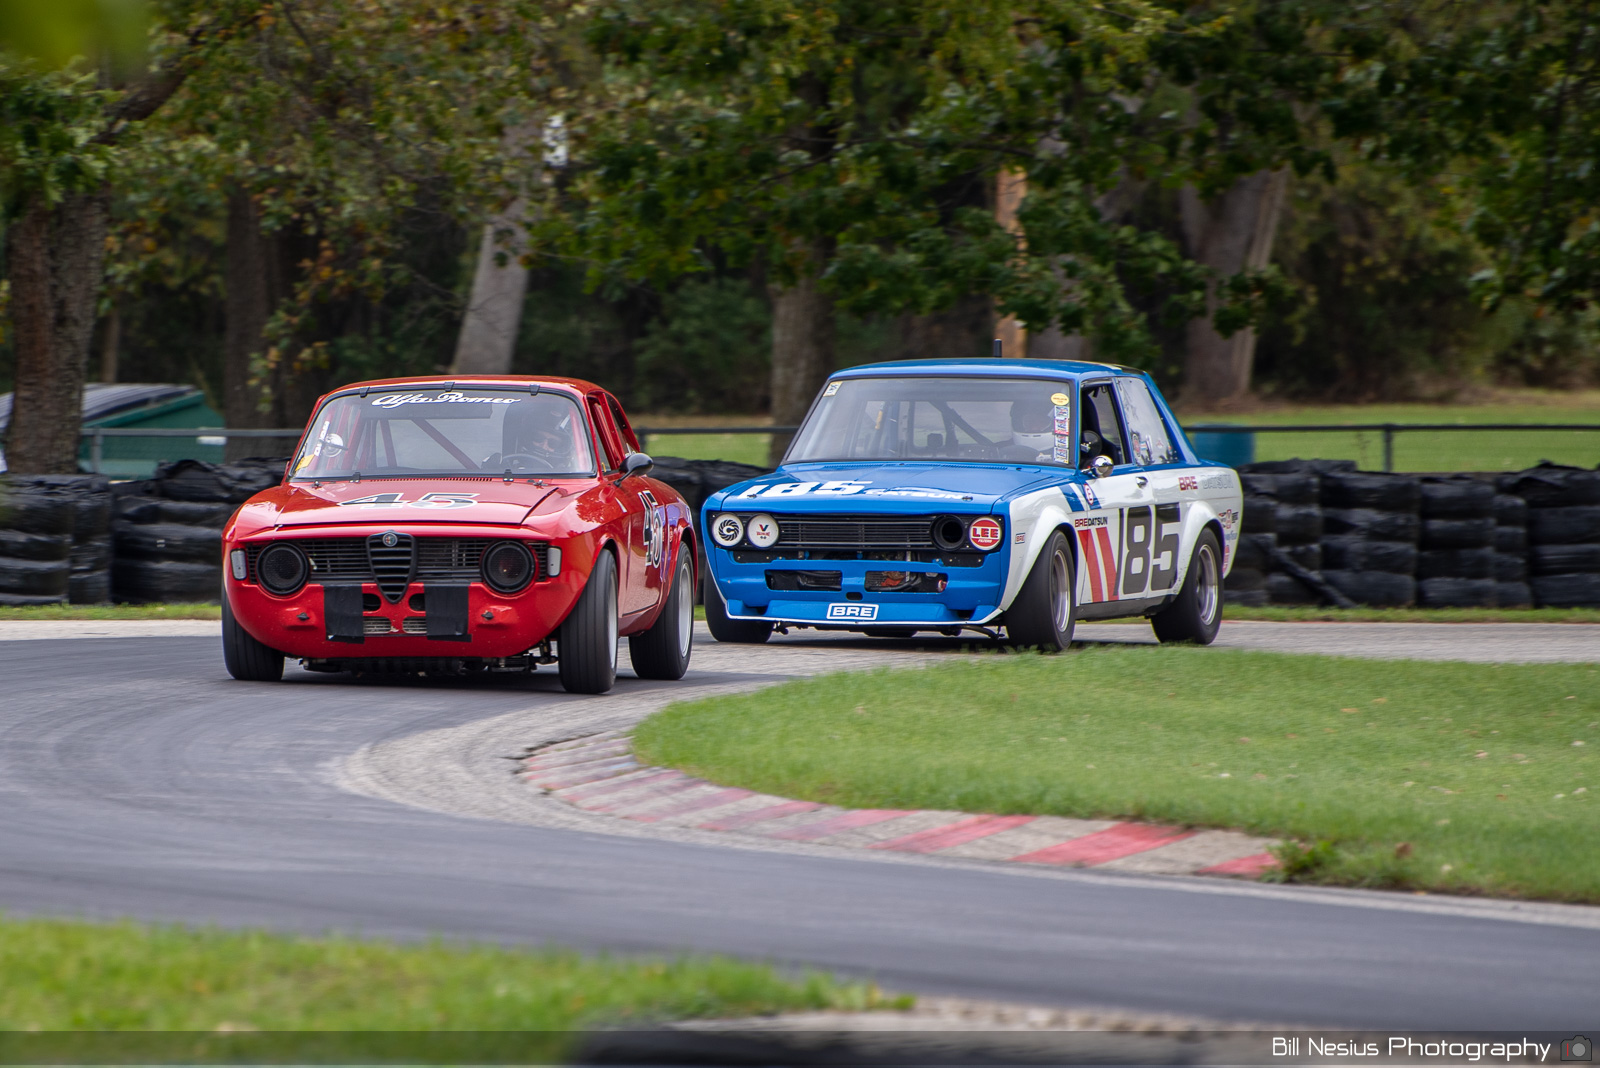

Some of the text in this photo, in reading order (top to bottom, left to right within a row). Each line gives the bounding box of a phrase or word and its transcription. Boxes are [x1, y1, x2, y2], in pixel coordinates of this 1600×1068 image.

[371, 391, 522, 409] Alfa Romeo
[737, 481, 874, 499] 185
[1178, 476, 1198, 491] BRE
[336, 492, 481, 510] 45
[637, 489, 663, 569] 45
[972, 527, 999, 539] LEE
[1112, 502, 1181, 596] 185
[832, 606, 873, 617] BRE
